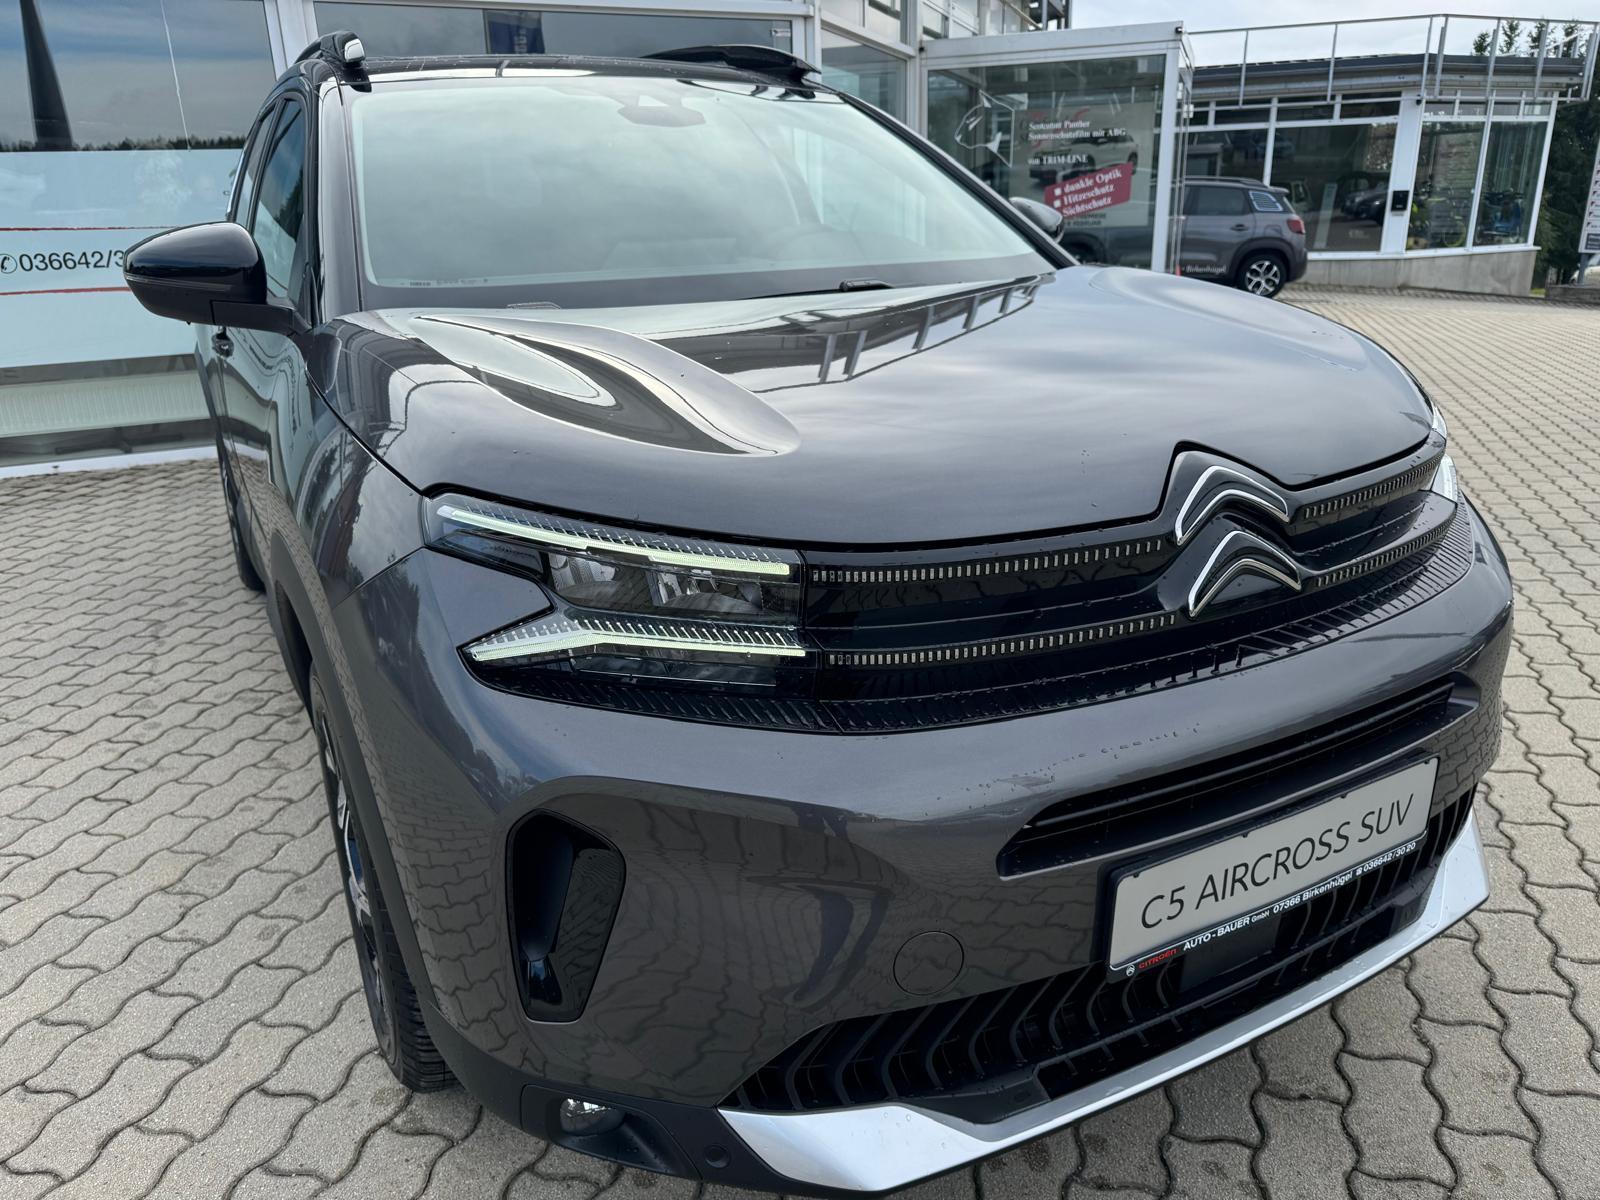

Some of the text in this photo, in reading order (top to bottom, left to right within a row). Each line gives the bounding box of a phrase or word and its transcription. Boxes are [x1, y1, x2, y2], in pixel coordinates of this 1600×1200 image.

[1063, 168, 1123, 193] dunkle Optik
[1062, 196, 1112, 217] Sichtschutz
[1063, 184, 1115, 206] Hitzeschutz
[19, 249, 125, 272] 036642/3
[1141, 793, 1414, 929] C5 AIRCROSS SUV
[1251, 909, 1271, 923] GmbH
[1273, 895, 1301, 914] 07366
[1302, 870, 1353, 901] Birkenhügel
